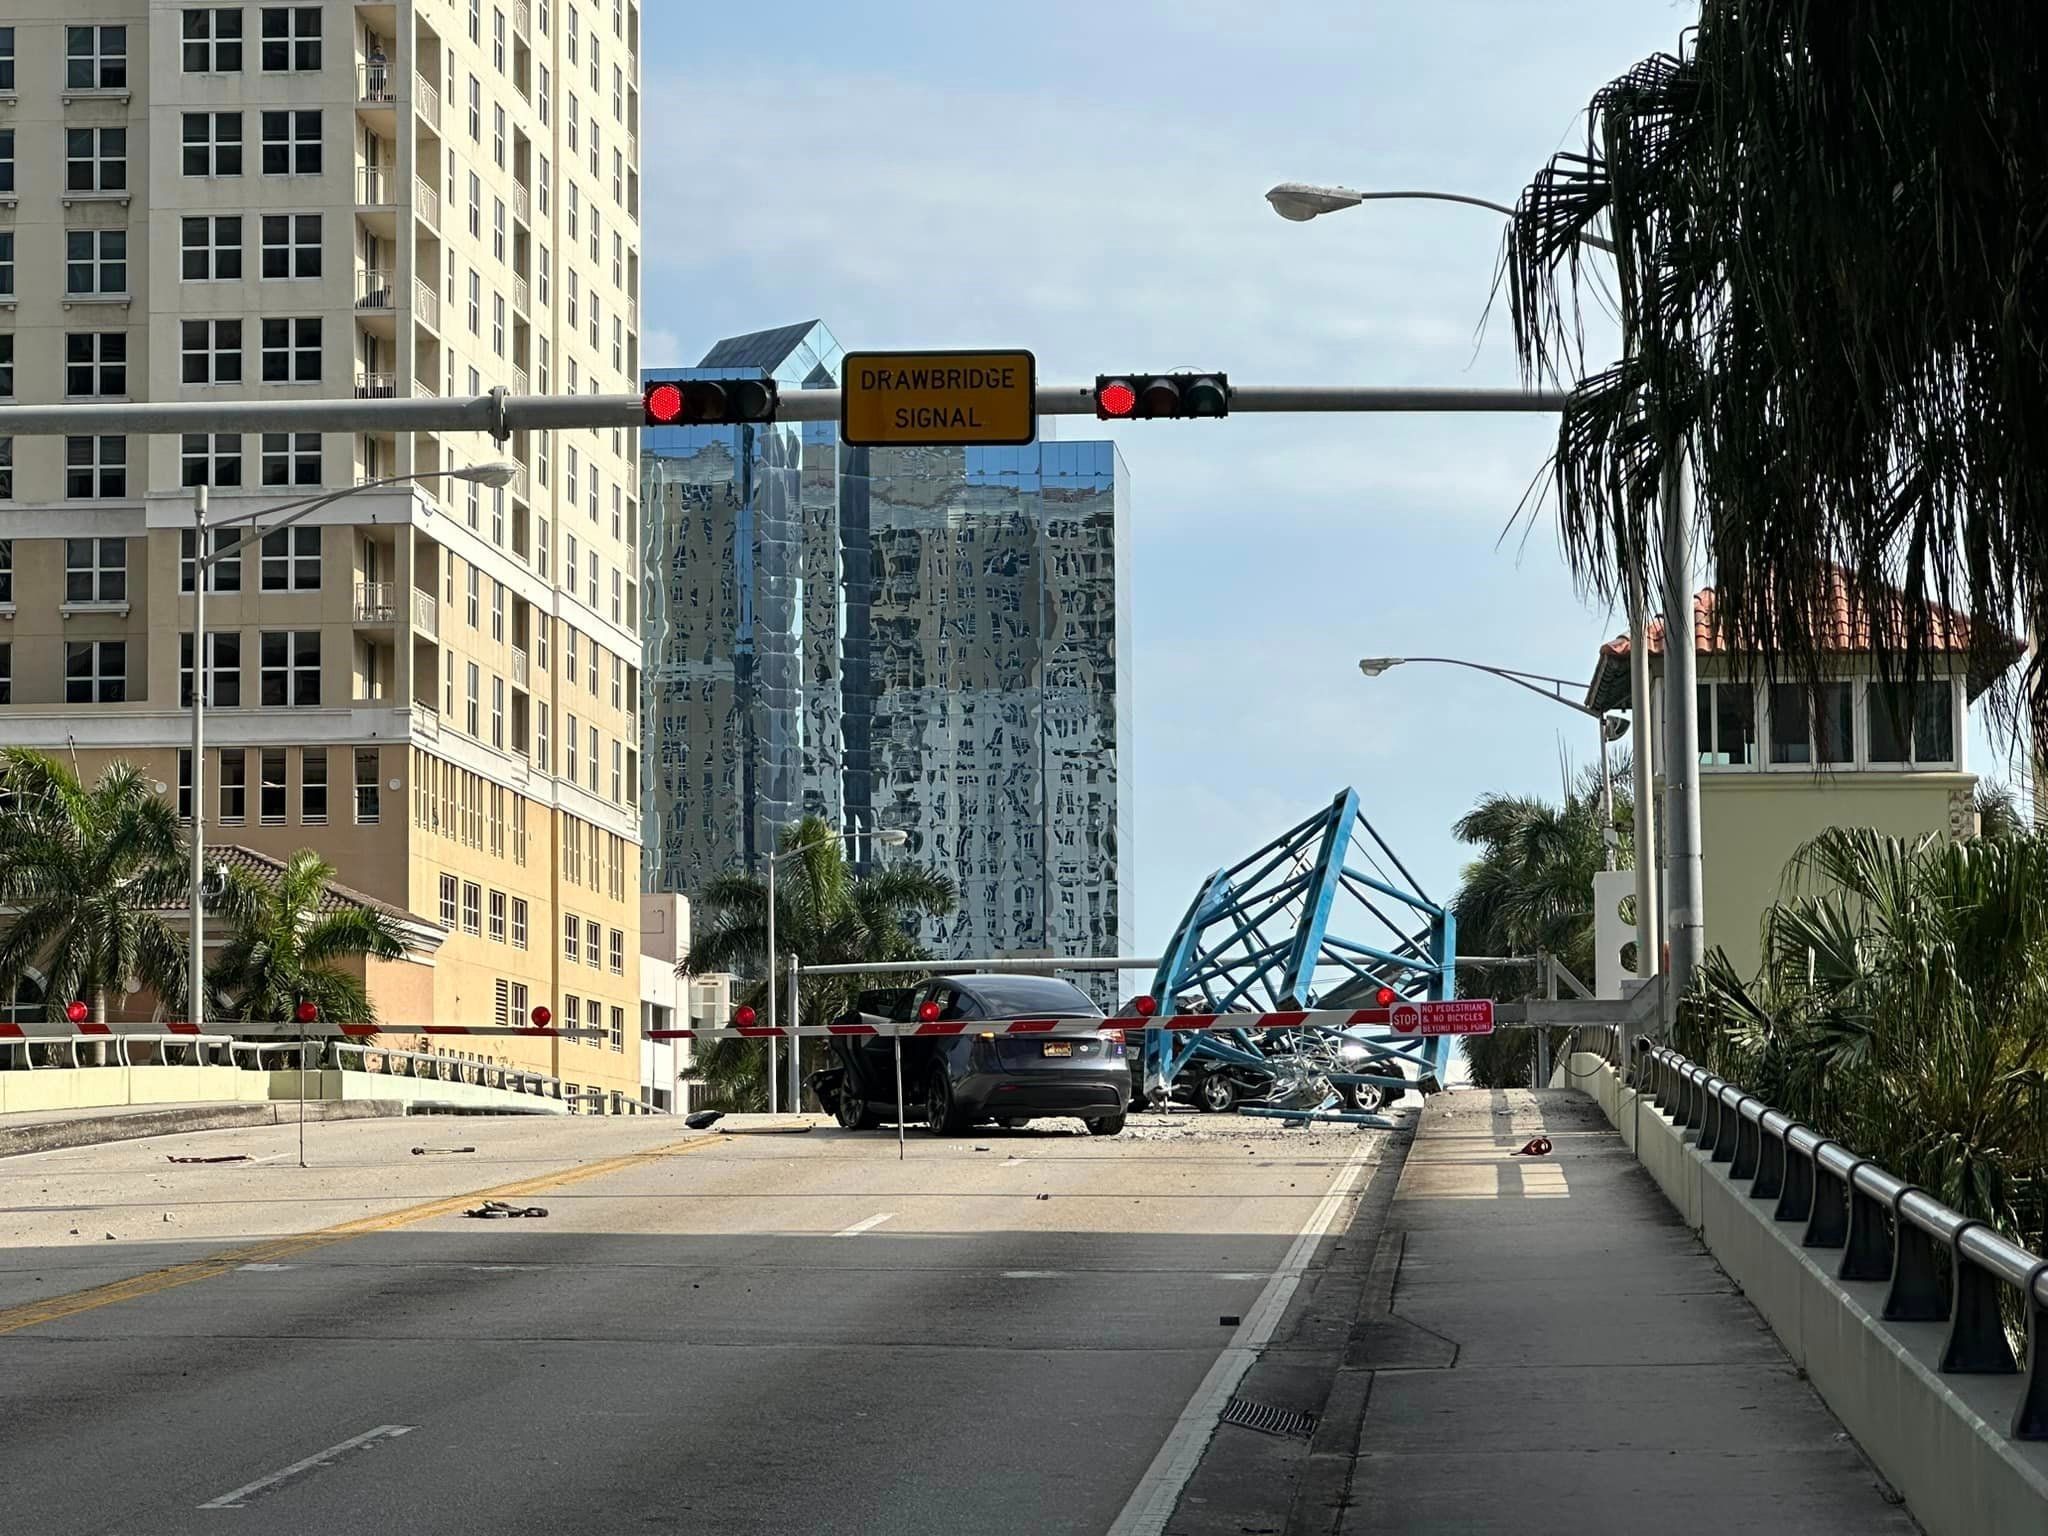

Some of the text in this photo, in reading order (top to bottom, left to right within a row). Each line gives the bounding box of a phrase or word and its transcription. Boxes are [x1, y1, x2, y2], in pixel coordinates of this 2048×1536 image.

[861, 368, 1015, 390] DRAWBRIDGE
[895, 407, 982, 428] SIGNAL
[1422, 1003, 1487, 1013] NO PEDESTRIANS
[1393, 1014, 1418, 1026] STOP
[1447, 1013, 1483, 1022] BICYCLES
[1422, 1022, 1490, 1033] BEYOND THIS POINT
